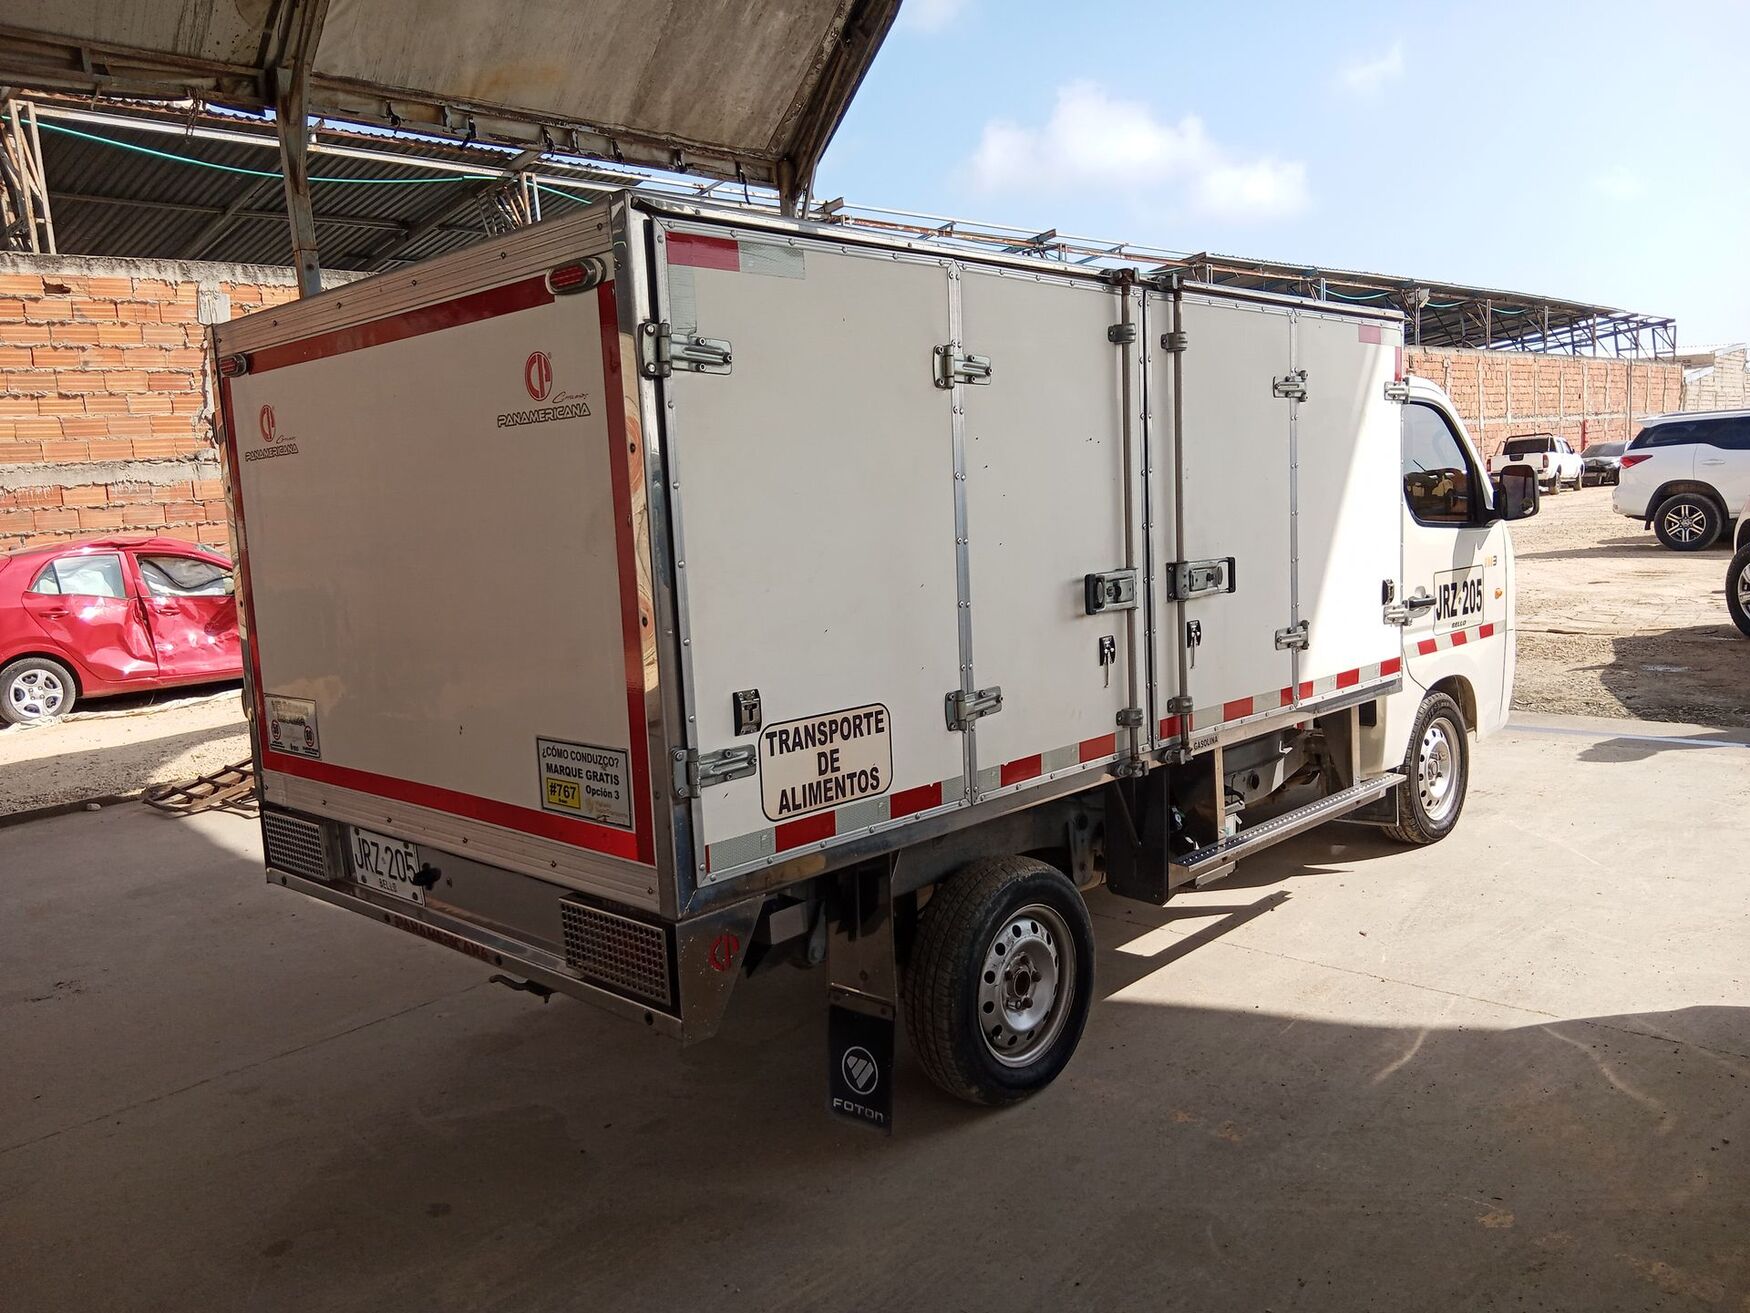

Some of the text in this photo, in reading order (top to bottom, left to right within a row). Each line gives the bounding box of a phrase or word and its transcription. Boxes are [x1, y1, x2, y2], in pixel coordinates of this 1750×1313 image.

[497, 402, 591, 428] PANAMERICANA
[765, 709, 885, 757] TRANSPORTE
[1193, 735, 1219, 750] GASOLINA
[542, 745, 620, 769] ¿CÓMO CONDUZCO?
[817, 748, 841, 777] DE
[546, 763, 620, 786] MARQUE GRATIS
[549, 782, 577, 800] #767
[585, 784, 620, 800] Opción 3
[778, 766, 881, 815] ALIMENTOS
